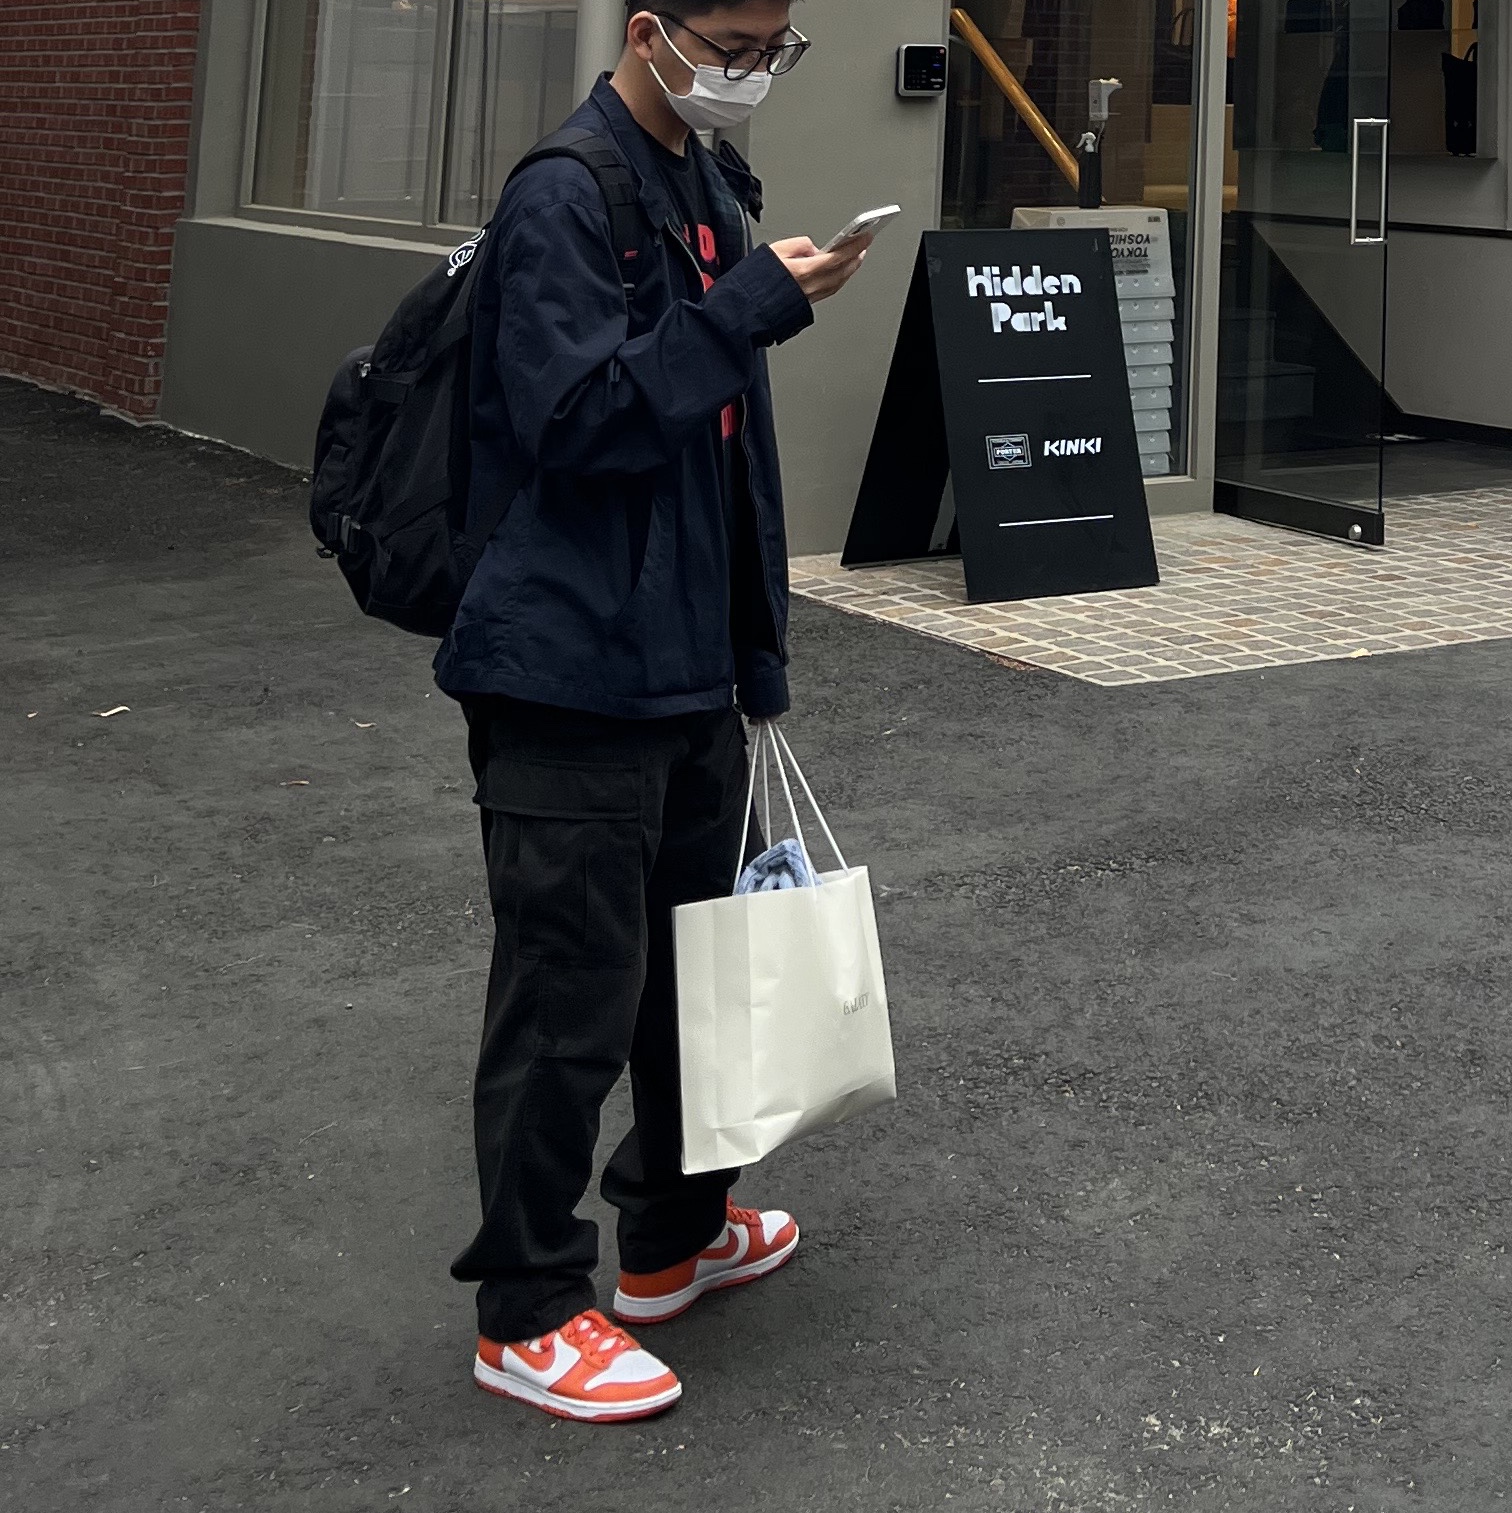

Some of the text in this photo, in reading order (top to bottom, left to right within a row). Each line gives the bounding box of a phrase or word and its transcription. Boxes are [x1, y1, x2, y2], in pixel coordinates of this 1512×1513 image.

[1110, 246, 1149, 259] TOKYO
[966, 265, 1082, 297] Hidden
[990, 300, 1067, 333] Park
[1043, 437, 1102, 457] KINKI
